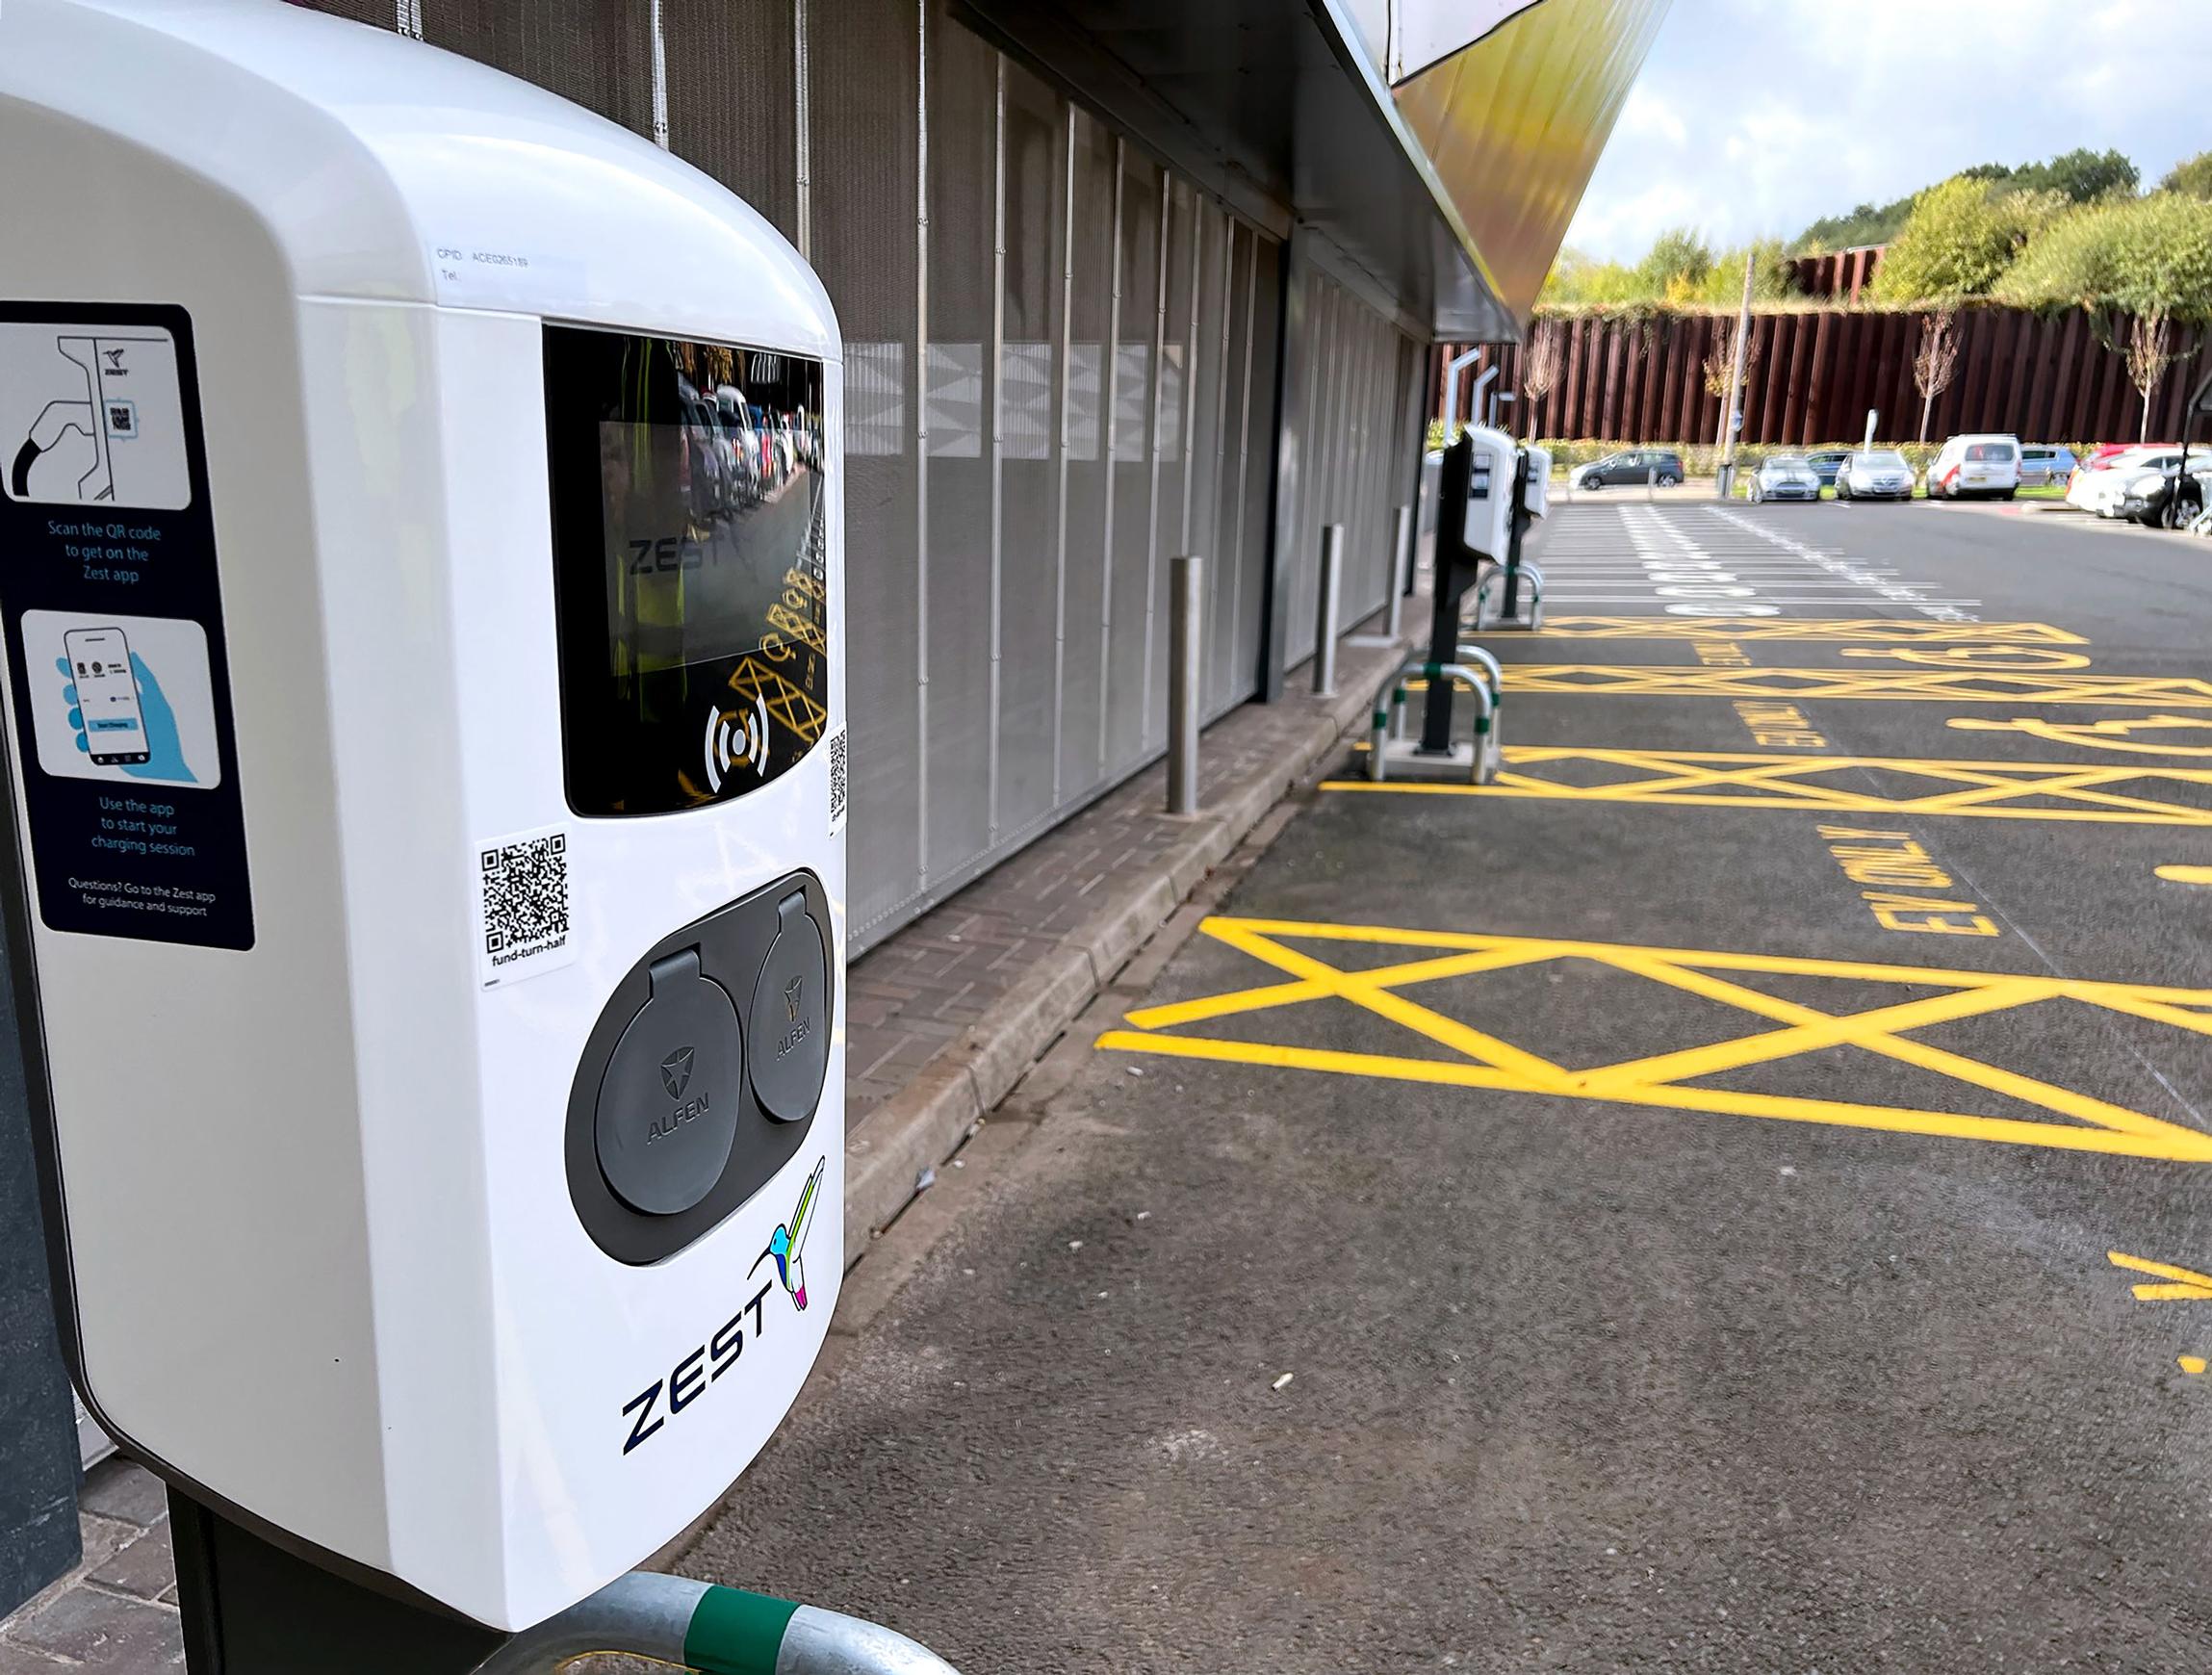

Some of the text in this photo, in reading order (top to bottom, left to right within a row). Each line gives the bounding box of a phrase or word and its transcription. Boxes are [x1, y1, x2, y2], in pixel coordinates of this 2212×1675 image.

[47, 520, 162, 541] Scan the QR code
[65, 544, 148, 561] to get on the
[83, 564, 140, 584] Zest app
[99, 796, 174, 818] Use the app
[101, 817, 177, 837] to start your
[90, 835, 195, 856] charging session
[67, 877, 217, 904] Questions? Go to the Zest app
[83, 893, 208, 916] for guidance and support
[1860, 889, 2001, 938] EV
[492, 935, 566, 967] fund-turn-half
[777, 1017, 810, 1062] ALFEN
[647, 1093, 709, 1146] ALFEN
[622, 1279, 773, 1456] ZEST
